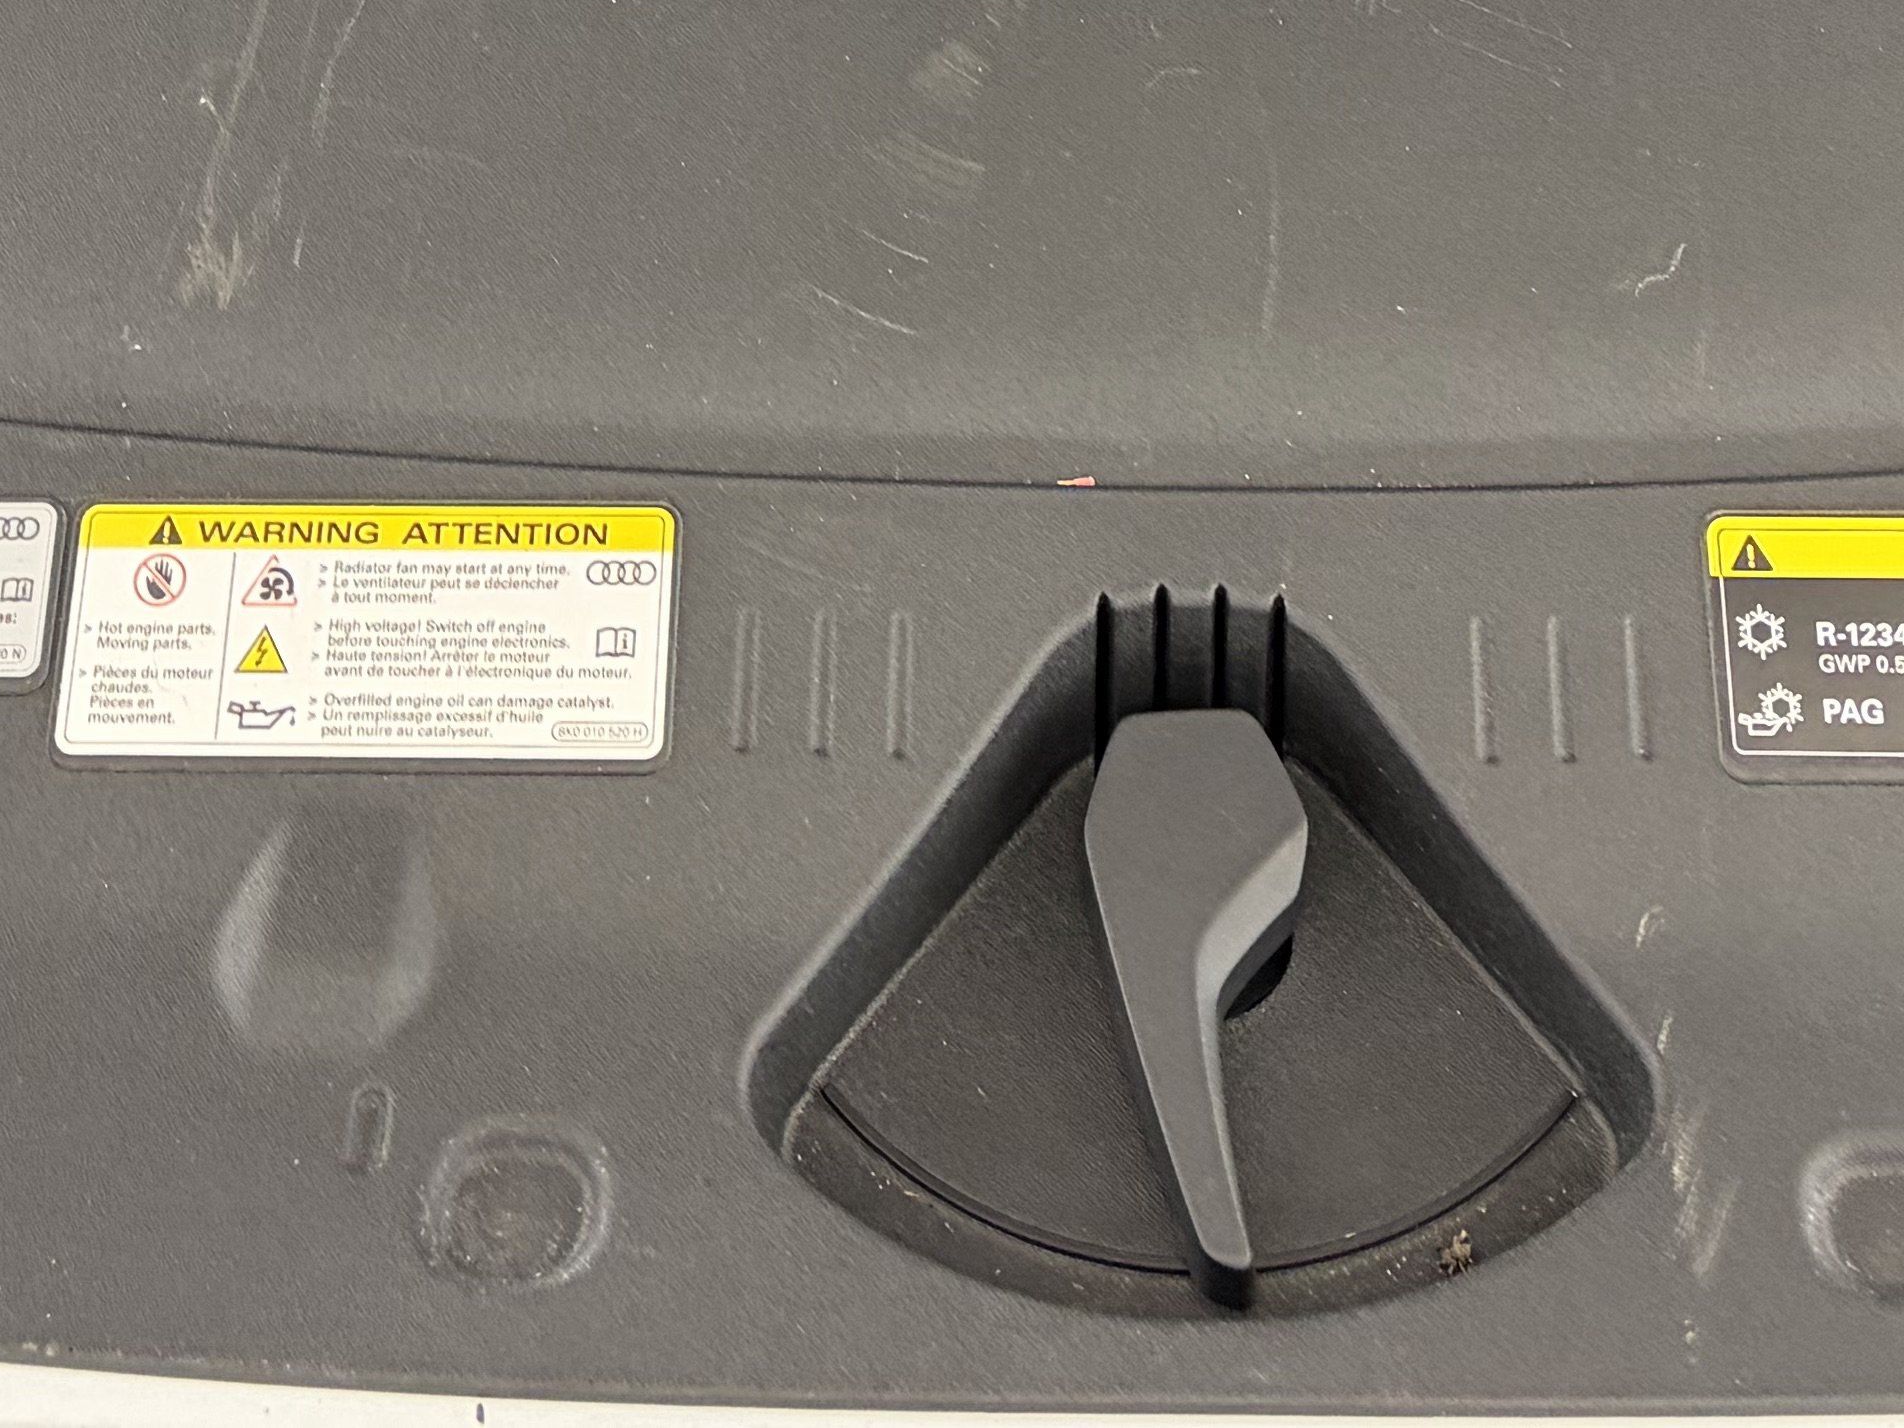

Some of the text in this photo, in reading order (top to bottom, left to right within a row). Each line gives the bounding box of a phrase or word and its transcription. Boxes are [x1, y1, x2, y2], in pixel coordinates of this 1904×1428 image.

[199, 521, 608, 545] WARNING ATTENTION
[334, 560, 570, 577] Radiator fan may start at any time.
[333, 577, 558, 591] Le ventilateur peut se déclencher
[344, 592, 371, 603] tout
[375, 592, 436, 603] moment.
[99, 621, 215, 636] Hot engine parts.
[329, 619, 545, 636] High voltage! Switch off engine
[97, 636, 191, 652] Moving parts.
[328, 634, 570, 651] before touching engine electronics.
[12, 648, 21, 659] N
[326, 649, 550, 663] Haute tension! Arrêter le moteur
[1818, 655, 1871, 673] GWP
[93, 665, 213, 680] Pièces du moteur
[325, 666, 362, 676] avant
[366, 665, 384, 676] de
[389, 665, 441, 677] toucher
[556, 666, 573, 678] du
[579, 667, 631, 679] moteur.
[92, 681, 152, 693] chaudes.
[90, 695, 154, 709] Pièces en
[324, 694, 614, 711] Overfilled engine oil can damage catalyst.
[88, 711, 175, 724] mouvement.
[323, 710, 543, 725] Un remplissage excessif d'huile
[1823, 698, 1884, 724] PAG
[321, 725, 493, 740] peut nuire au catalyseur.
